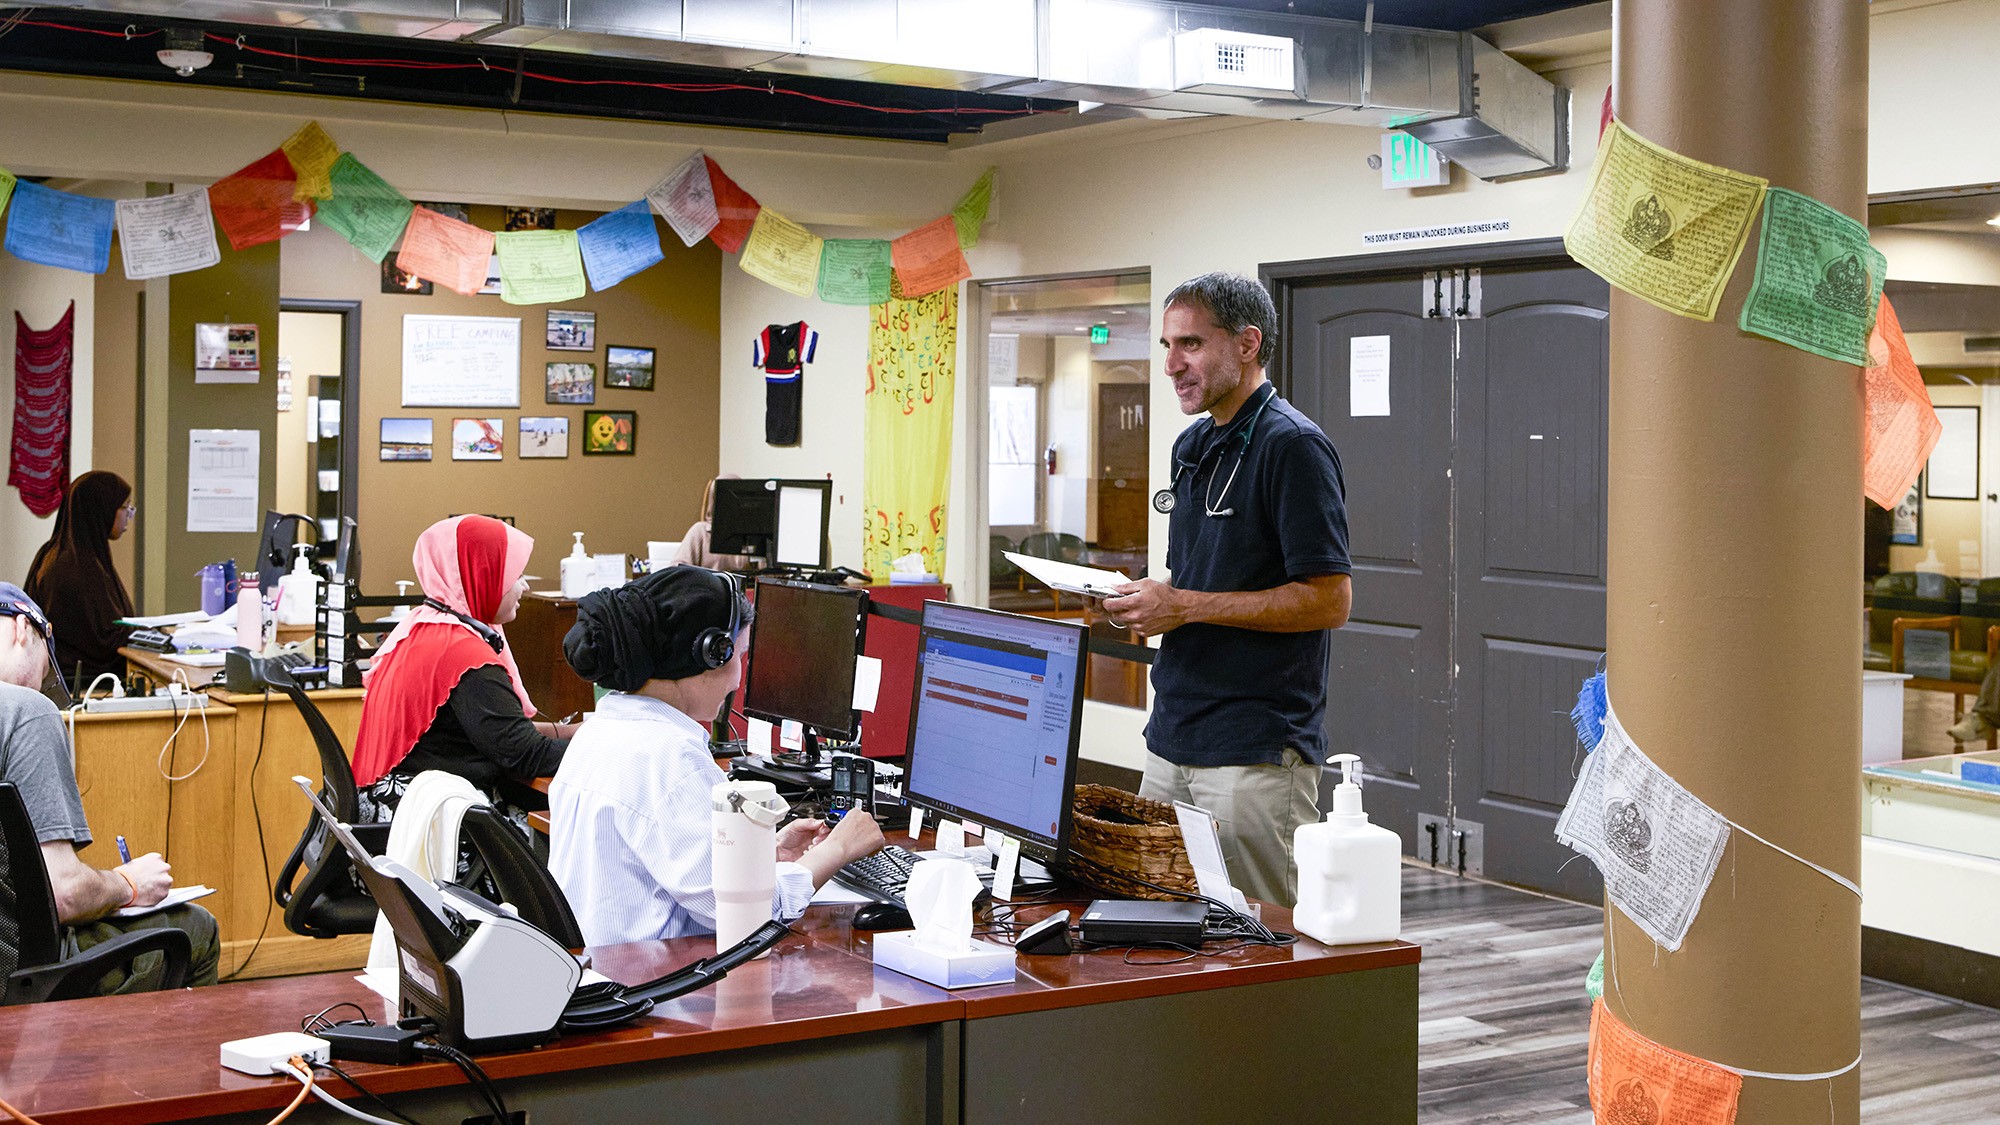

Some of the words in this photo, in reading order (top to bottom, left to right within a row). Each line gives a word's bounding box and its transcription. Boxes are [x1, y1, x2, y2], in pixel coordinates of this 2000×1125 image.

[1364, 235, 1375, 243] THIS
[1375, 233, 1388, 242] DOOR
[1388, 232, 1402, 241] MUST
[1402, 230, 1421, 240] REMAIN
[1421, 227, 1446, 239] UNLOCKED
[1447, 226, 1466, 236] DURING
[1467, 223, 1491, 234] BUSINESS
[1492, 221, 1509, 231] HOURS
[415, 323, 462, 341] FREE
[467, 328, 516, 341] CAMPING
